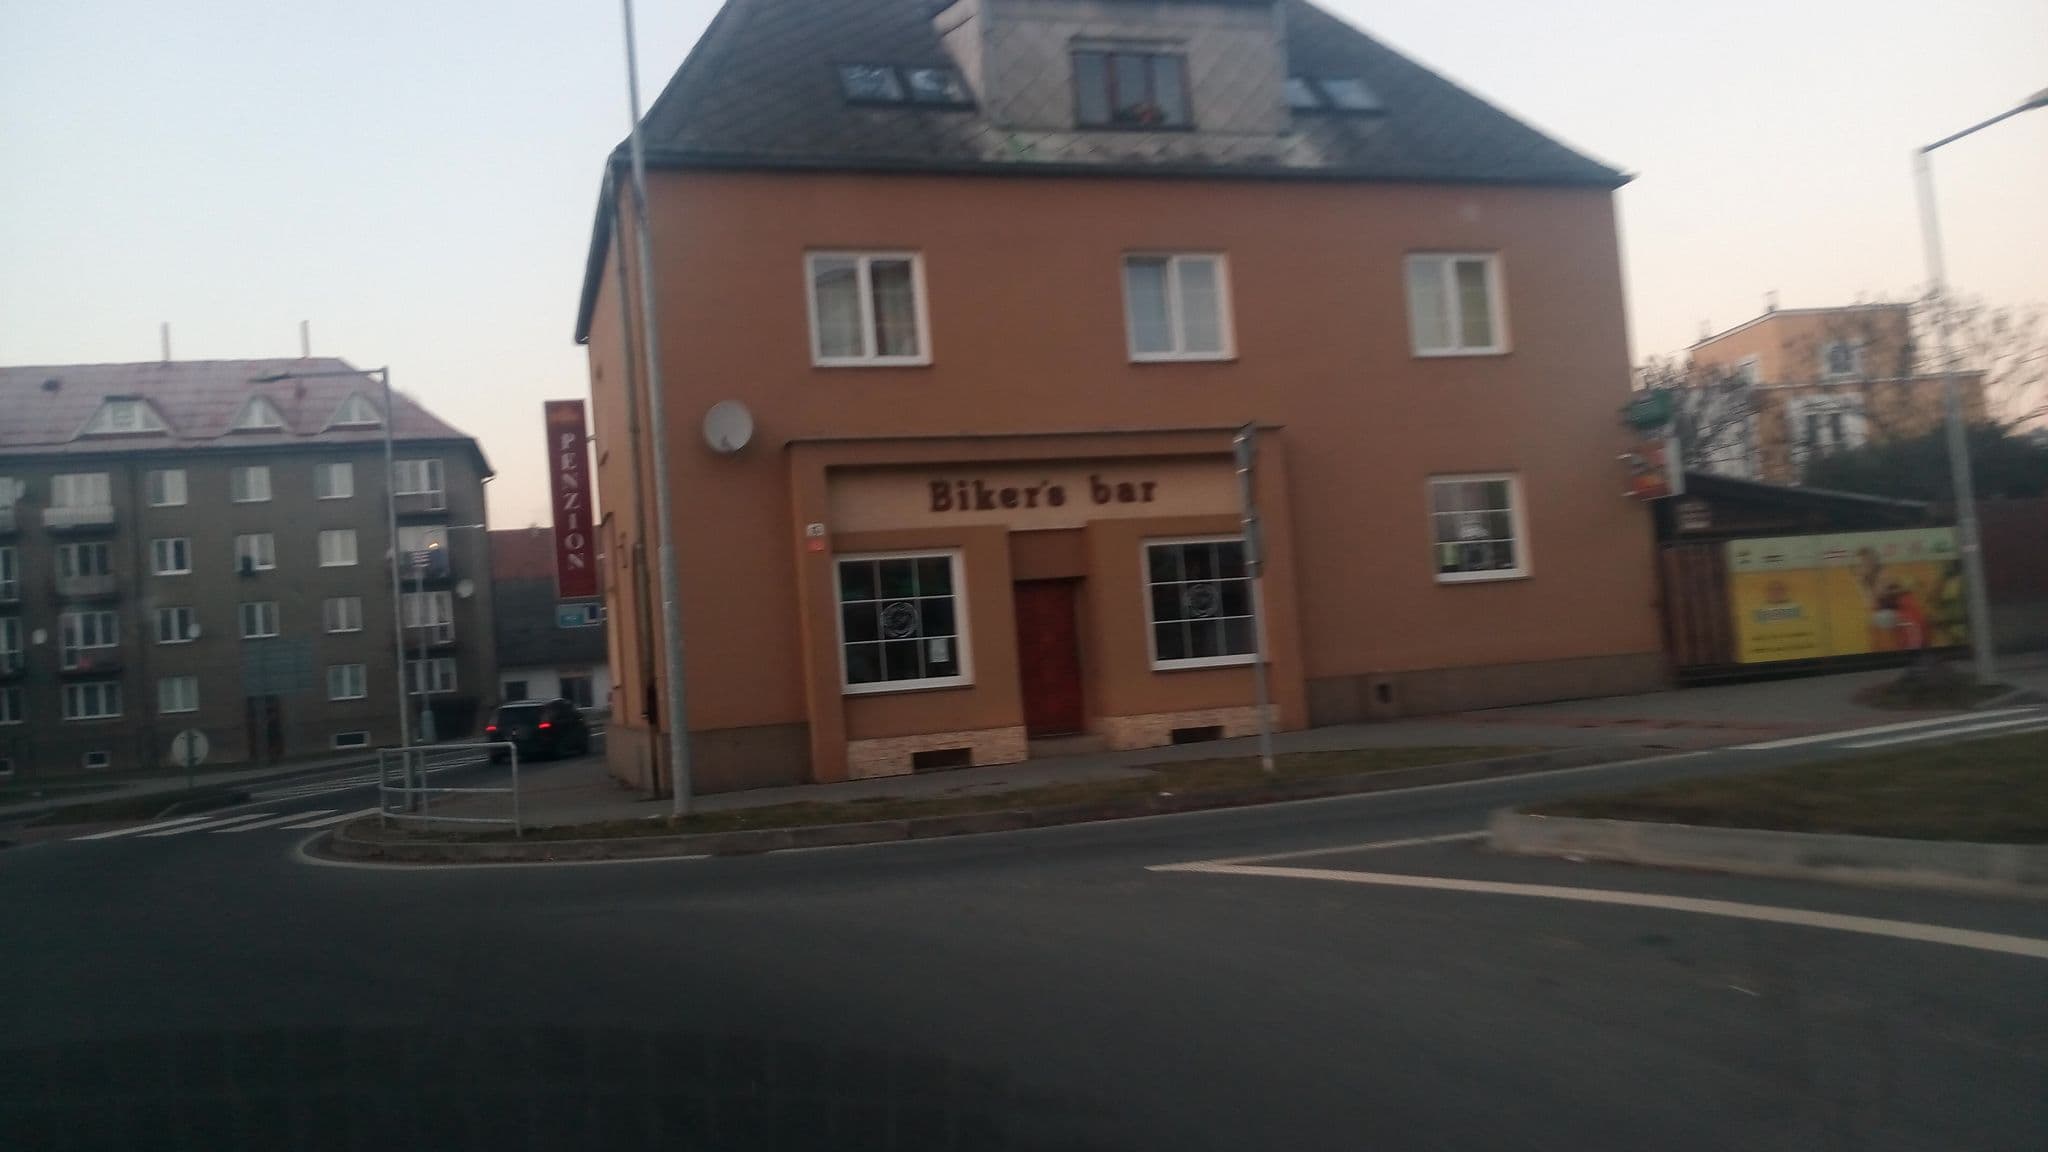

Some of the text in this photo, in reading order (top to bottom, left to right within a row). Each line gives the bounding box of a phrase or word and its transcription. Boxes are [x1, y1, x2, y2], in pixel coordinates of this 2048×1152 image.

[560, 432, 585, 570] PENZION
[929, 474, 1158, 513] Biker's bar
